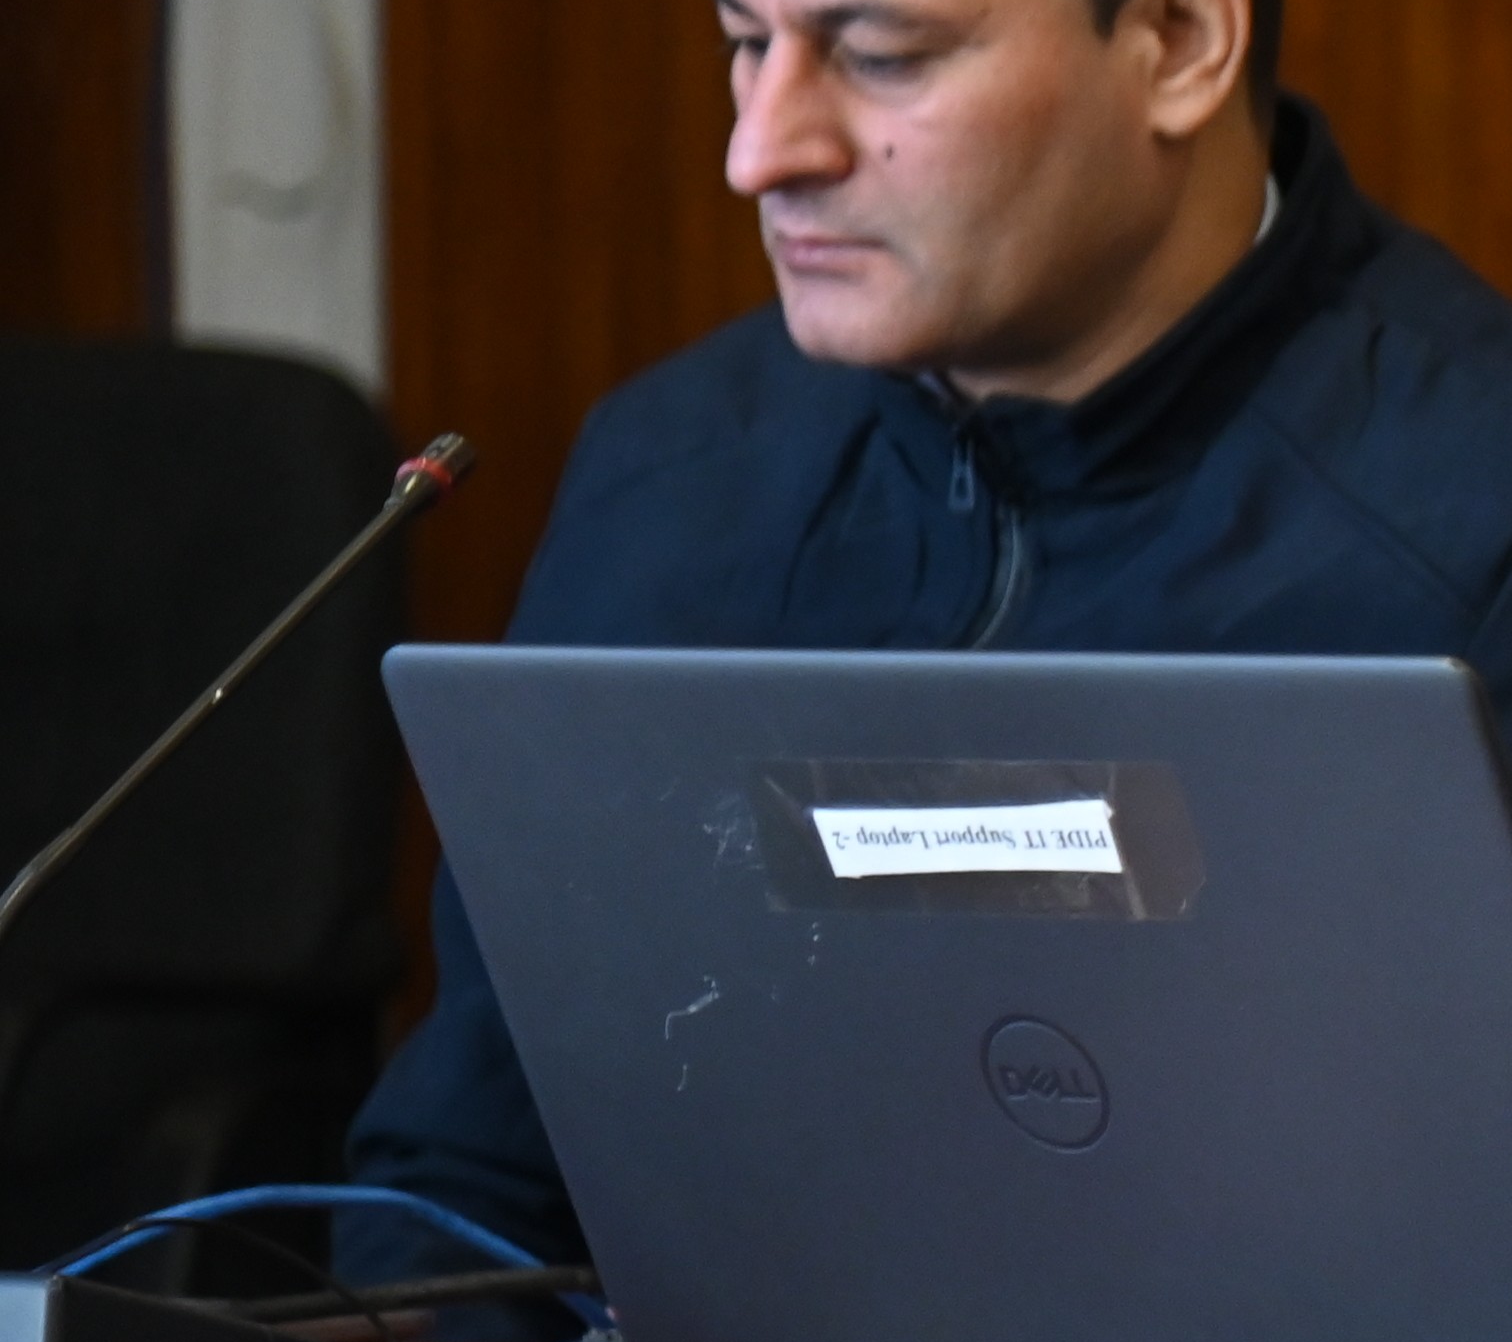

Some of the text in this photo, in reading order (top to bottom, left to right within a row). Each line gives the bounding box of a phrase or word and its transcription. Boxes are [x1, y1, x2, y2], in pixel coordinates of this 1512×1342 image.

[856, 824, 929, 850] Laptop
[935, 824, 1016, 850] Support
[1023, 829, 1047, 850] IT
[1052, 829, 1109, 850] PIDE
[1000, 1064, 1100, 1100] DELL
